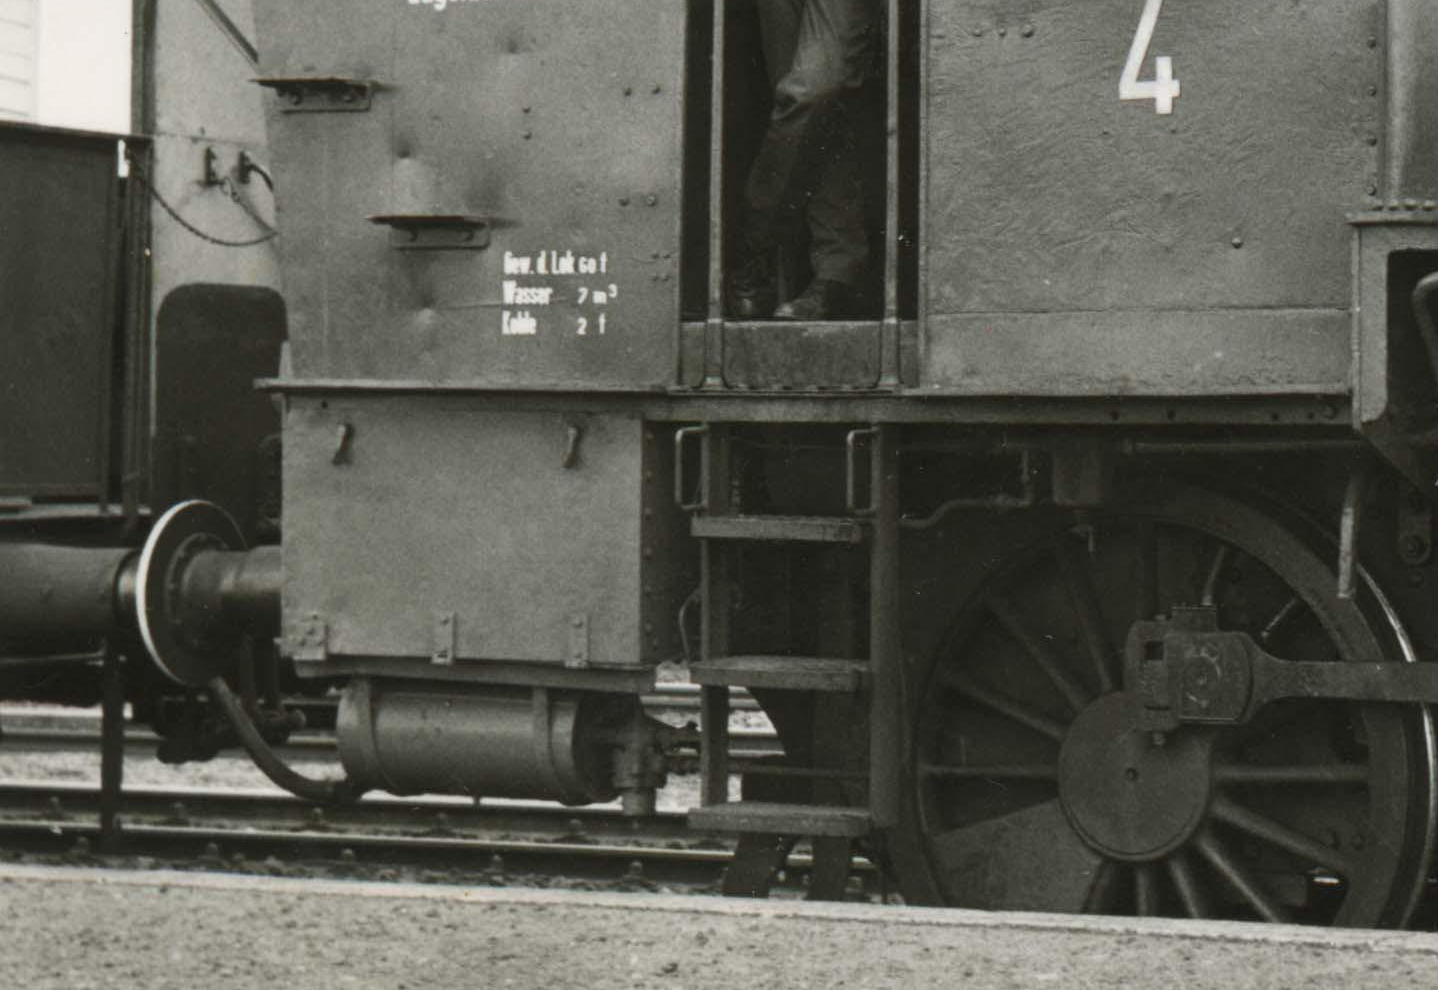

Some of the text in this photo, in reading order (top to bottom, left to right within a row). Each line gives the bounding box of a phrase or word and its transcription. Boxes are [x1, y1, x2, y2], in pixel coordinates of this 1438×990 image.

[502, 280, 553, 305] Wasser
[577, 287, 588, 304] 7
[576, 316, 588, 335] 2
[598, 313, 606, 335] t
